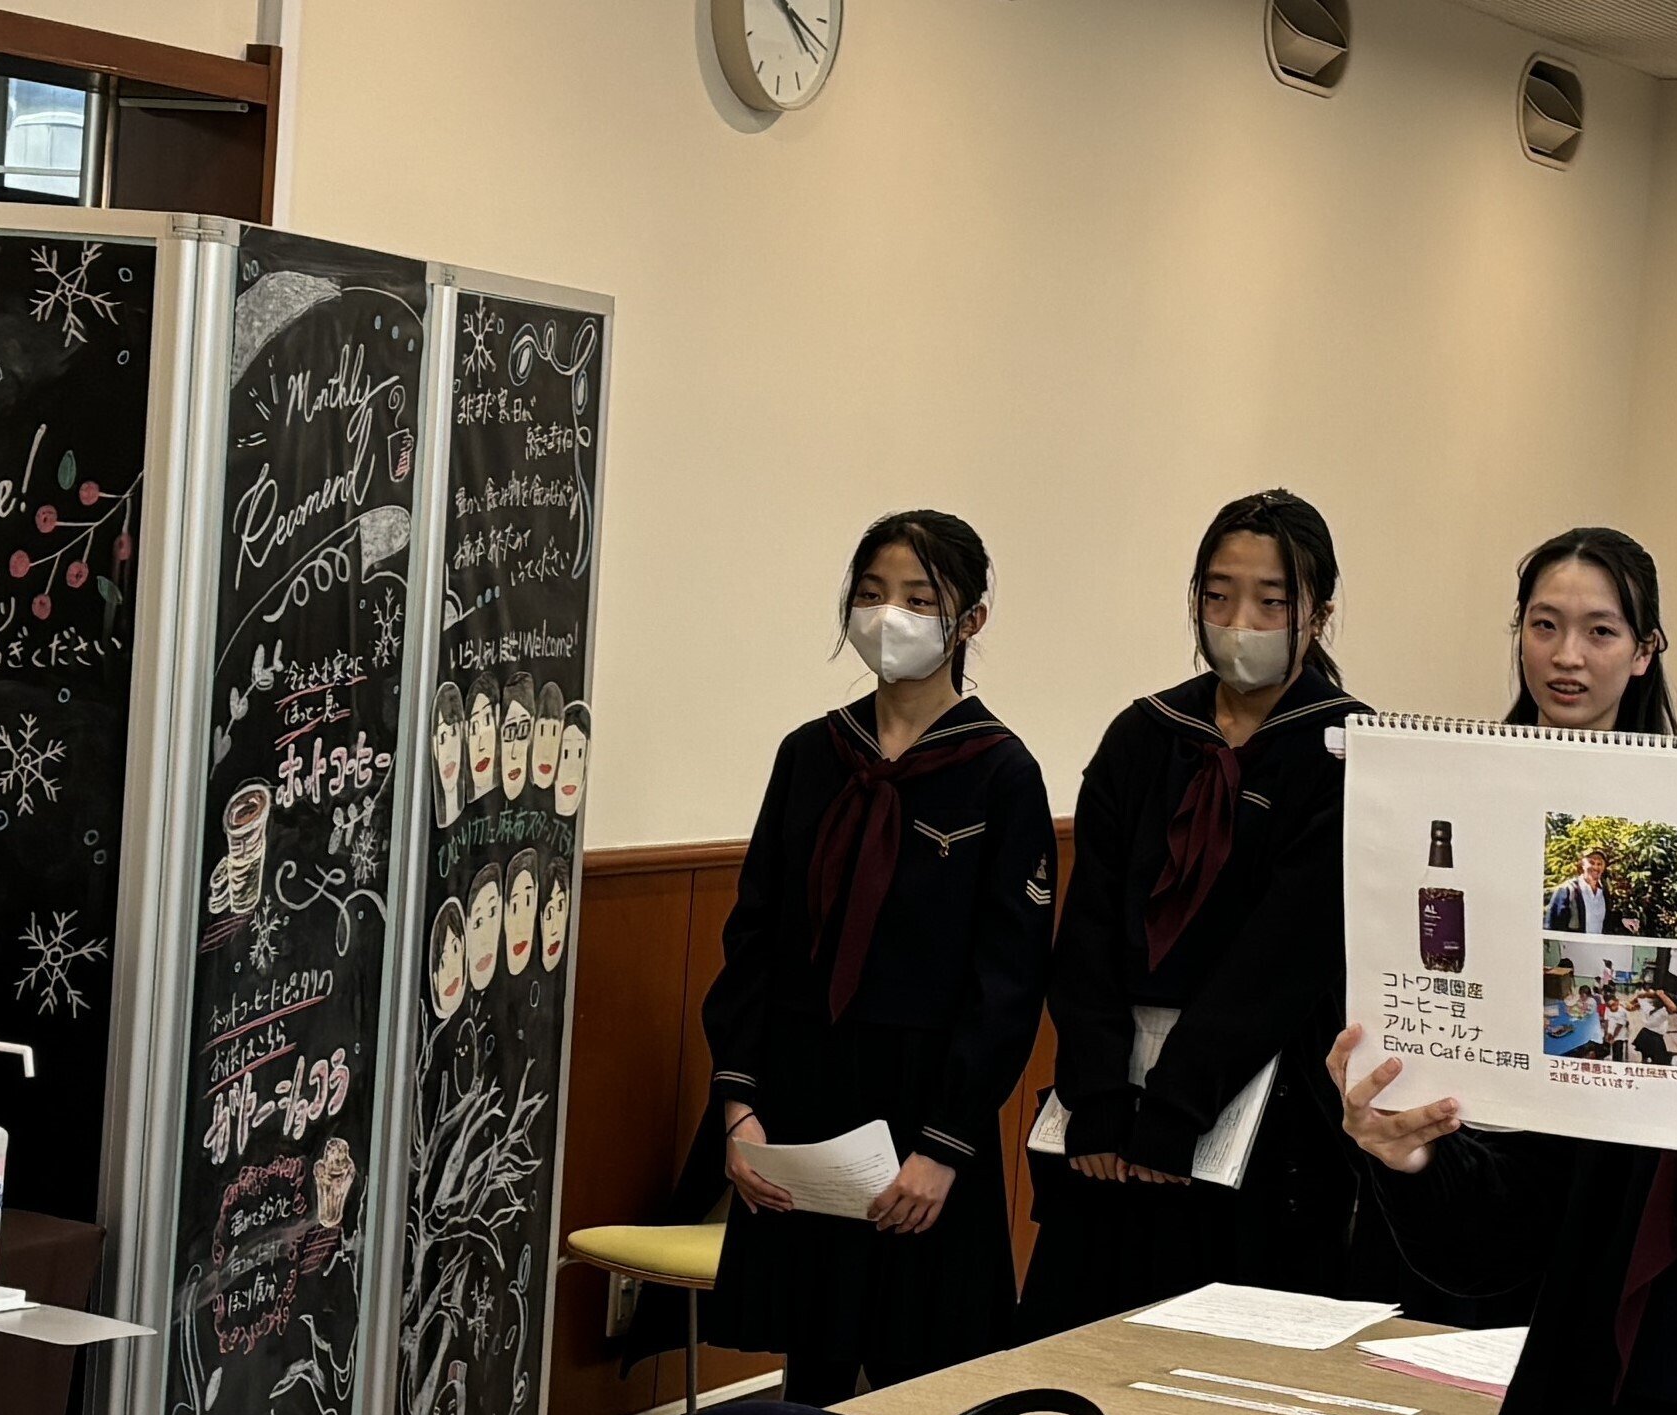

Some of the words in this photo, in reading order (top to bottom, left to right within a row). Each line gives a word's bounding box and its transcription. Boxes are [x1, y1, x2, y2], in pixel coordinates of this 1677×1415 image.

[286, 343, 400, 443] Monthly
[276, 731, 392, 808] ホットコーヒー
[1383, 993, 1466, 1019] コーヒー豆
[1383, 1013, 1483, 1041] アルト・ルナ
